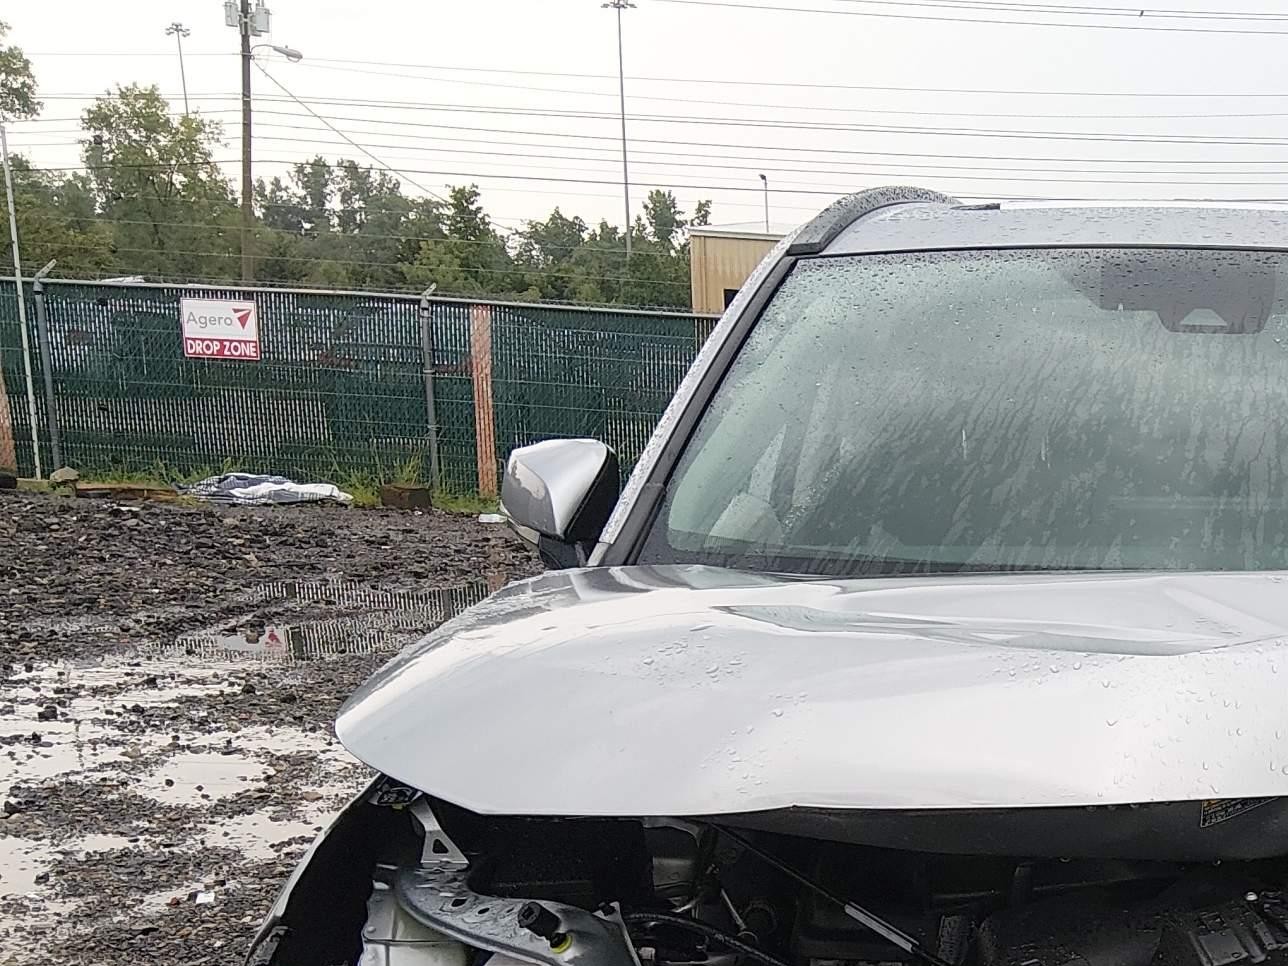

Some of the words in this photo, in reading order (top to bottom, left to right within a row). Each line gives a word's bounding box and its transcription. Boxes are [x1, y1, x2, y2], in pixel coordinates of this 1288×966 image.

[186, 311, 233, 329] Agero
[186, 339, 221, 355] DROP
[223, 341, 257, 357] ZONE
